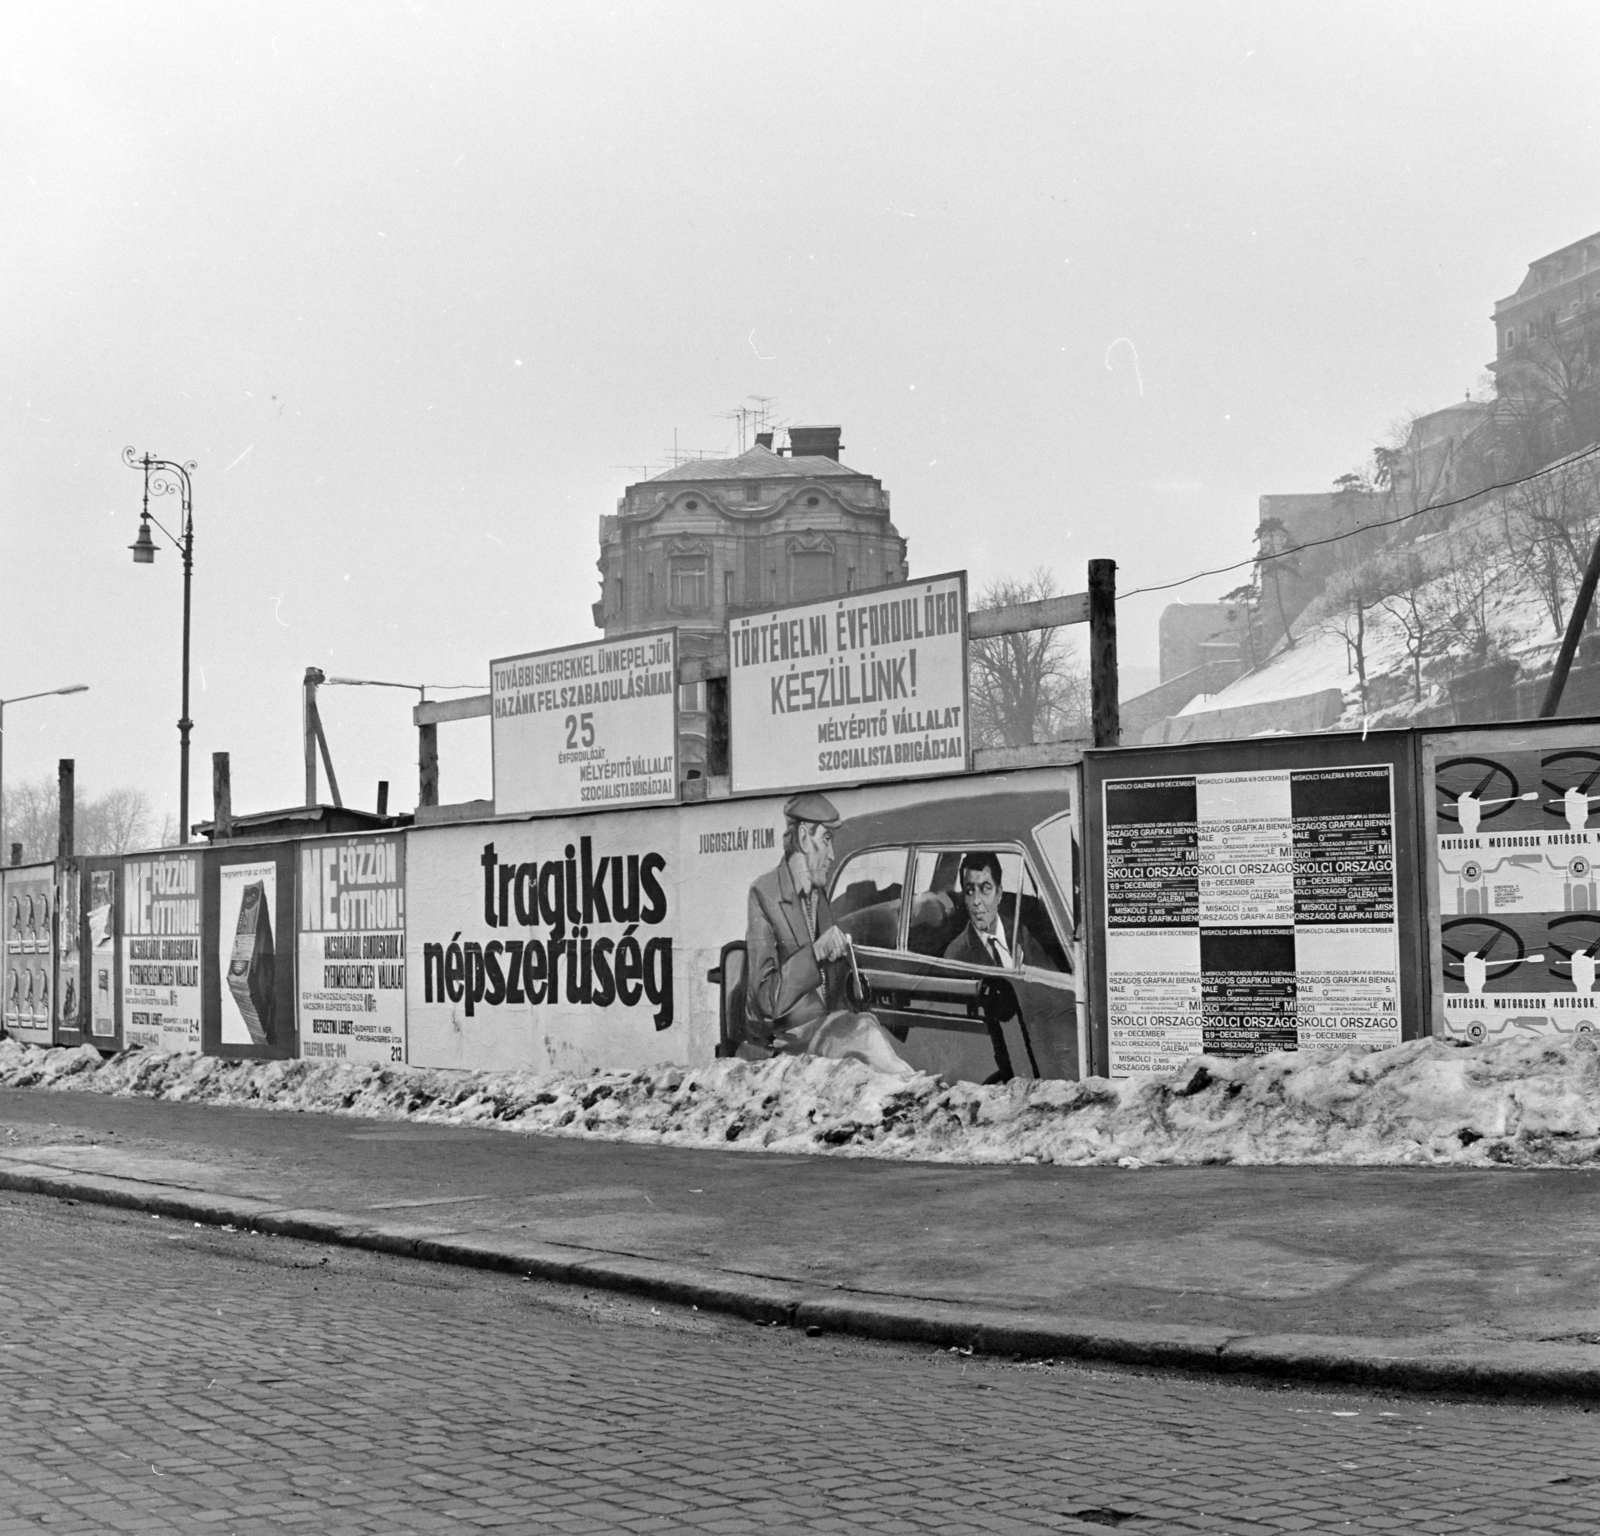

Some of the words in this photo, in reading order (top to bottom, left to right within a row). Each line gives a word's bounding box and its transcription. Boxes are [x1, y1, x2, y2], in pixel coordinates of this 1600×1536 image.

[733, 614, 826, 667] TÖRTÉNELMI
[837, 585, 958, 651] ÉVFORDULÓRA
[495, 663, 533, 692] TOVÁBBI
[535, 654, 597, 685] SIKEREKKEL
[598, 638, 671, 674] ÜNNEPELJÜK
[495, 690, 536, 718] HAZÁNK
[538, 668, 672, 712] FELSZABADULÁSÁNAK
[771, 649, 917, 715] KÉSZÜLÜNK!
[565, 712, 594, 749] 25
[818, 709, 887, 743] MÉLYÉPITŐ
[893, 706, 960, 734] VÁLLALAT
[559, 746, 605, 764] ÉVFORDULÓJÁT
[633, 755, 672, 776] VÁLLALAT
[819, 745, 893, 771] SZOCIALISTA
[894, 734, 961, 764] BRIGÁDJAI
[581, 784, 630, 801] SZOCIALISTA
[630, 778, 672, 796] BRIGÁDJAI
[1141, 828, 1172, 836] GRAFIKAI
[1329, 821, 1363, 829] GRAFIKAI
[699, 831, 748, 853] JUGOSZLÁV
[753, 828, 774, 850] FILM
[1489, 837, 1541, 847] MOTOROSOK
[339, 837, 396, 885] FŐZZÖN
[1108, 868, 1143, 878] SKOLCI
[1198, 865, 1235, 875] SKOLCI
[1293, 863, 1332, 873] SKOLCI
[125, 862, 151, 934] NE
[302, 848, 337, 930] NE
[481, 835, 667, 942] tragikus
[152, 900, 199, 934] OTTHON!
[340, 888, 403, 930] OTTHON!
[378, 961, 404, 989] VÁLLALAT
[424, 925, 673, 1031] népszerüség
[1494, 999, 1546, 1009] MOTOROSOK
[1110, 1016, 1146, 1025] SKOLCI
[1202, 1017, 1240, 1027] SKOLCI
[1297, 1017, 1336, 1027] SKOLCI
